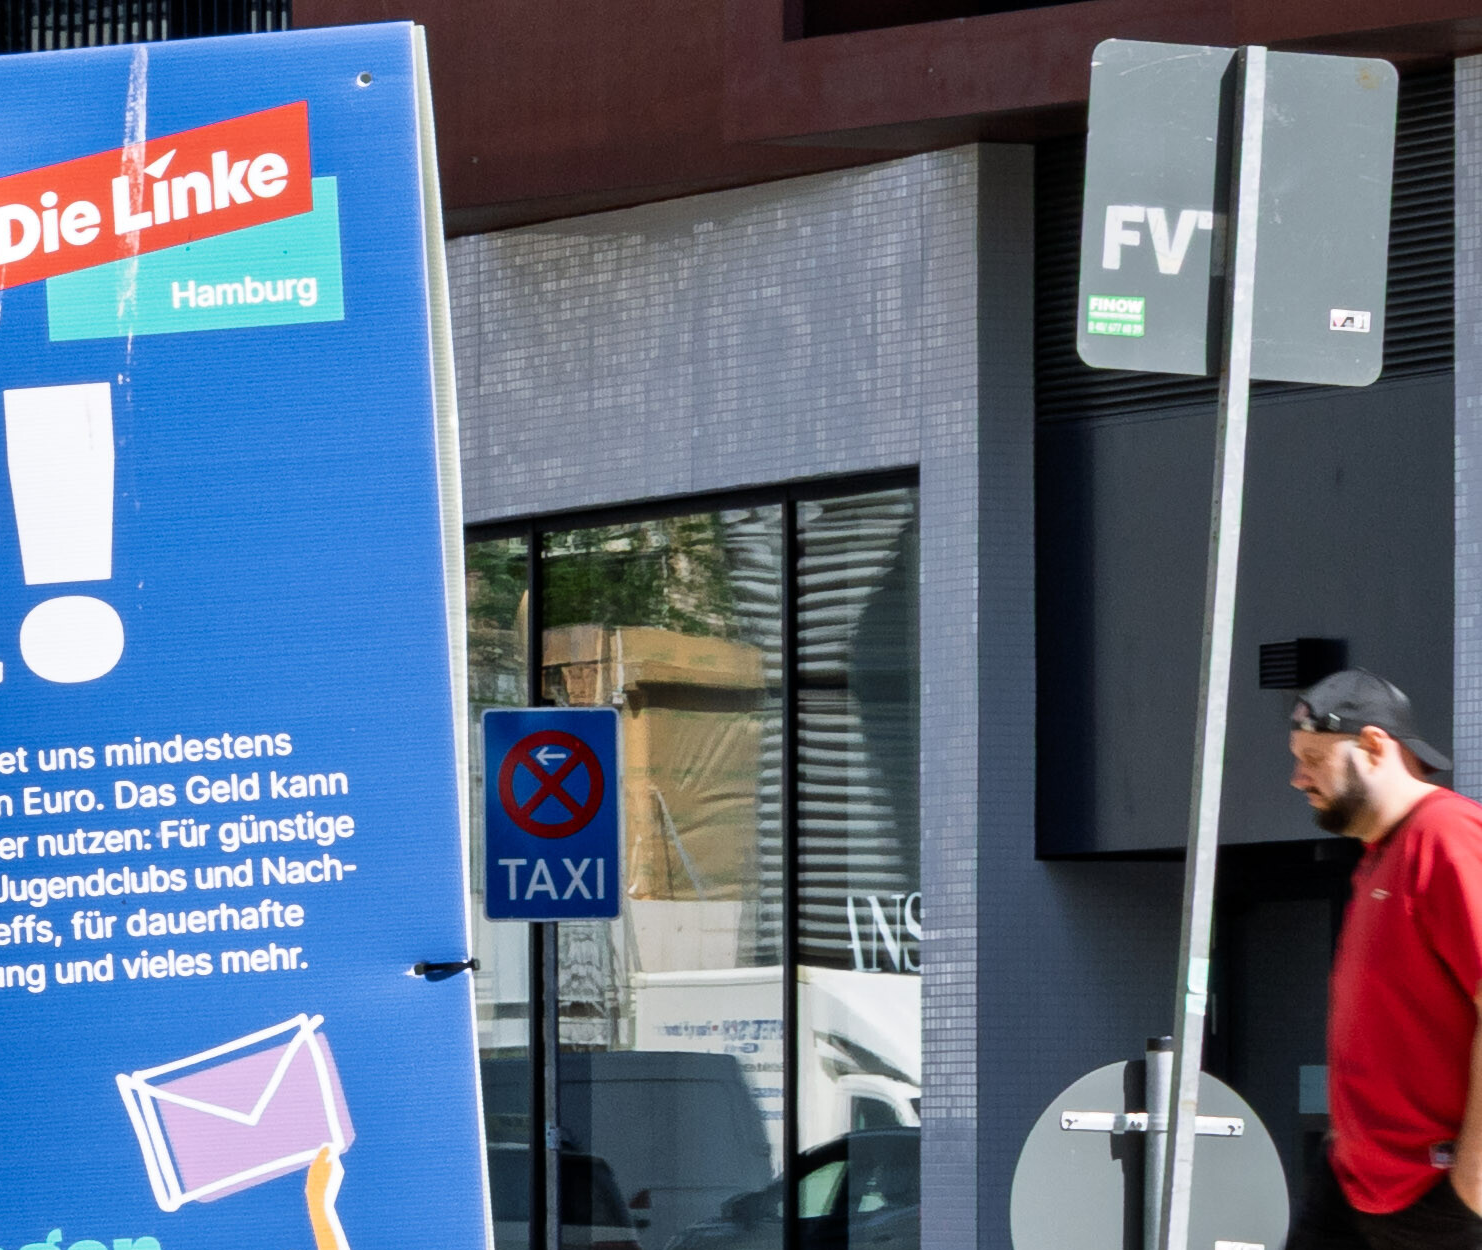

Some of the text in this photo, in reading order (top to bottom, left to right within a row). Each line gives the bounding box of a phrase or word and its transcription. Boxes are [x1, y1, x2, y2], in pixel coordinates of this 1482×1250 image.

[111, 149, 290, 236] Linke
[170, 275, 319, 309] Hamburg
[1089, 297, 1144, 314] FINOW
[38, 744, 96, 773] uns
[104, 732, 293, 769] mindestens
[23, 784, 105, 818] Euro.
[114, 779, 177, 812] Das
[185, 772, 261, 806] Geld
[270, 768, 350, 801] kann
[37, 826, 152, 859] nutzen:
[160, 816, 211, 851] Für
[219, 810, 356, 848] günstige
[194, 858, 254, 890] und
[261, 850, 358, 887] Nach-
[497, 857, 605, 901] TAXI
[70, 908, 119, 943] für
[126, 898, 306, 939] dauerhafte
[55, 951, 114, 984] und
[121, 945, 214, 979] vieles
[221, 940, 310, 975] mehr.
